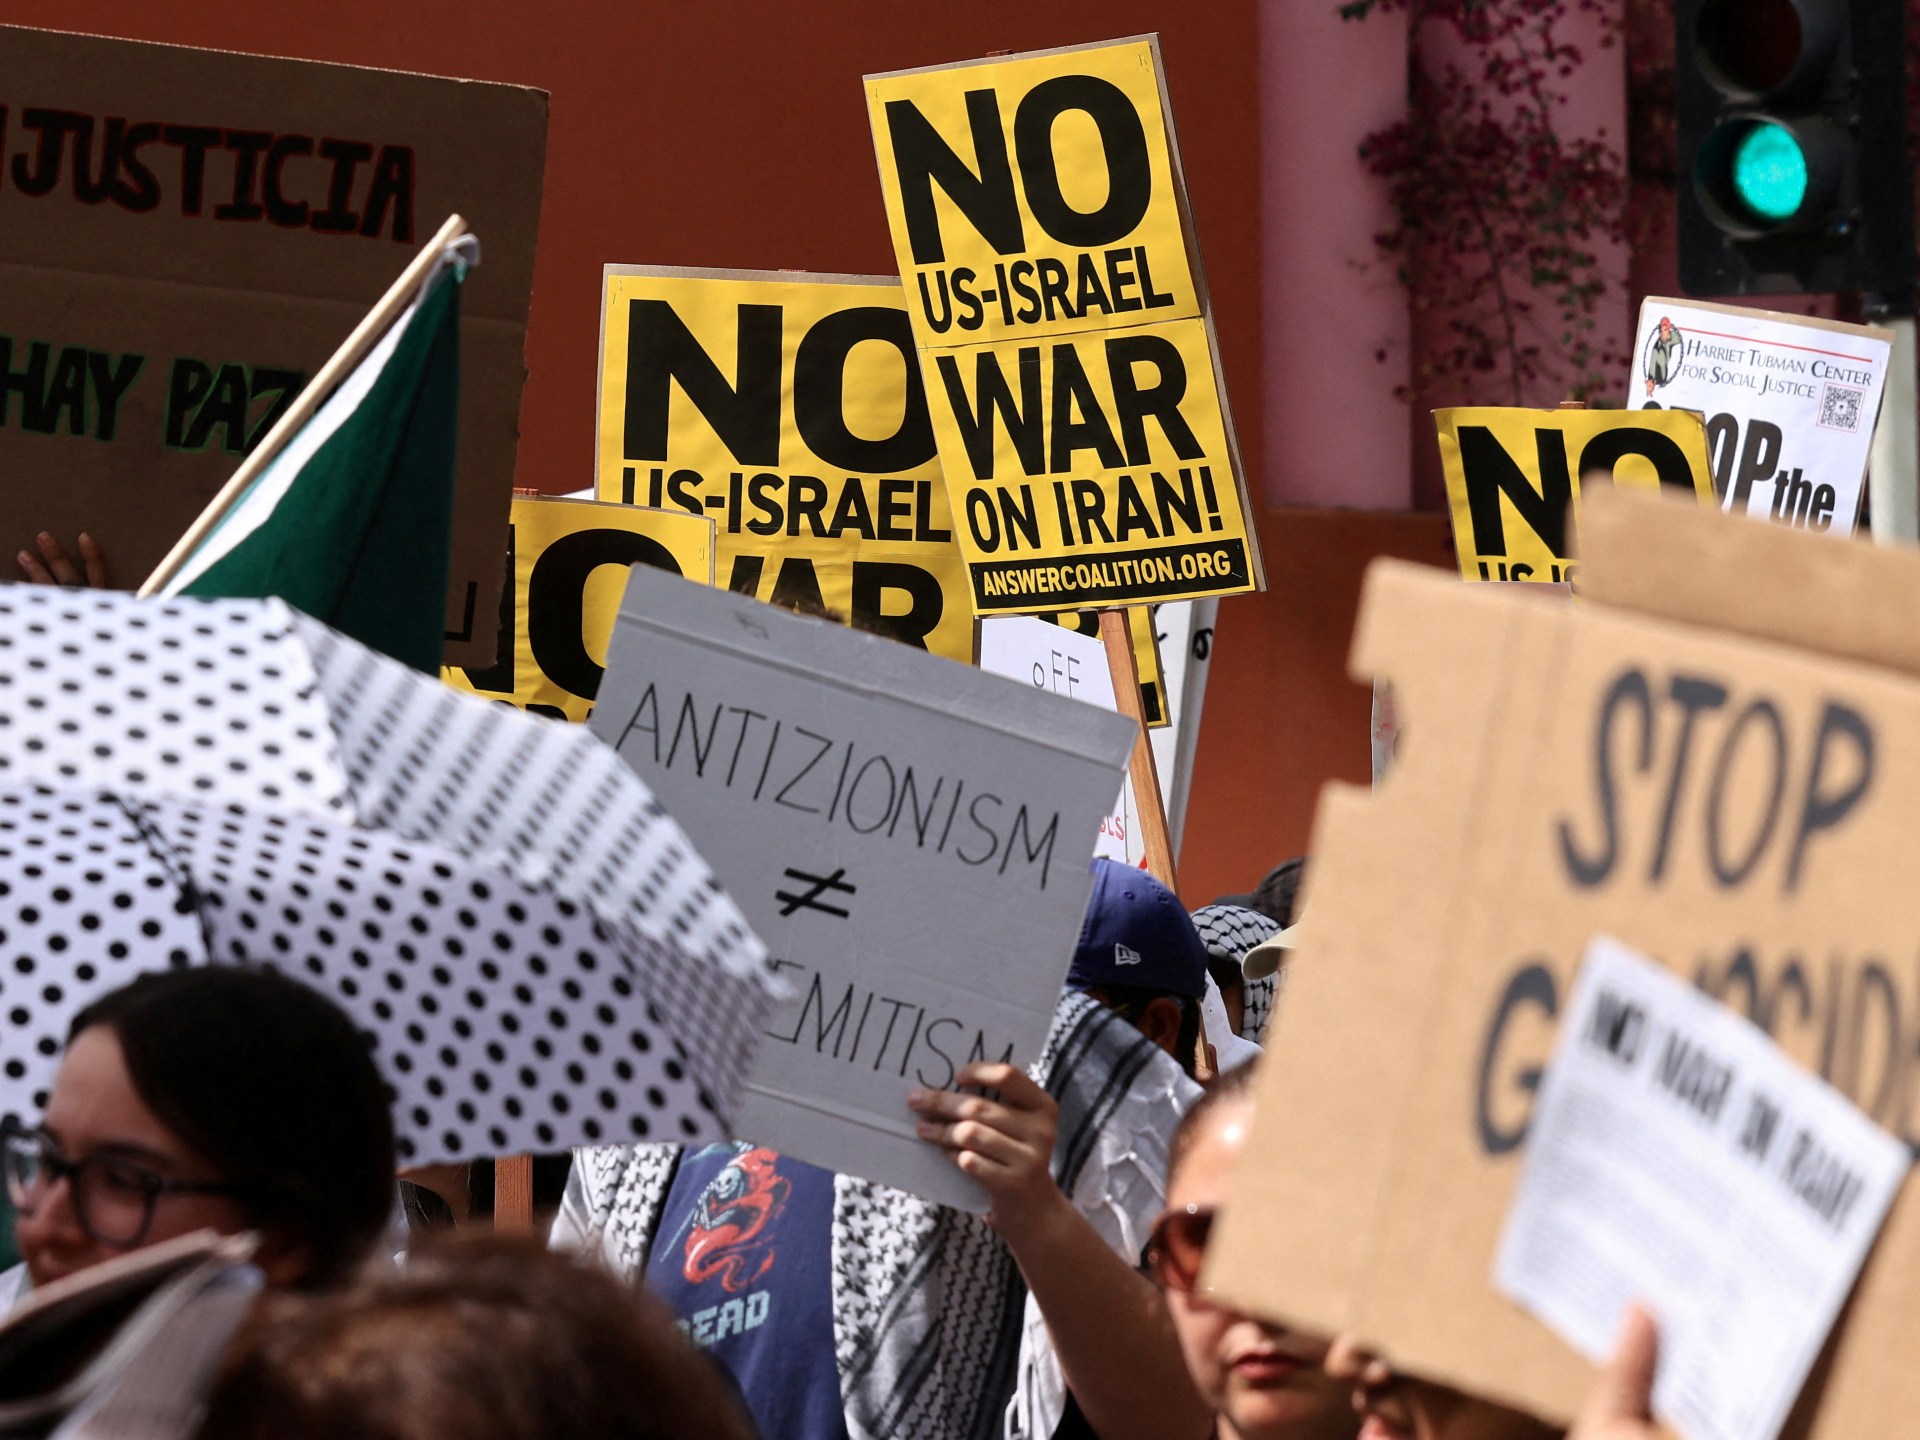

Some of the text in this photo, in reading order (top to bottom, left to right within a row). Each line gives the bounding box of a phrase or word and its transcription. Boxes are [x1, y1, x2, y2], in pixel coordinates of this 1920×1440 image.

[11, 107, 415, 244] JUSTICIA
[884, 75, 1152, 264] NO
[917, 246, 1175, 334] US-ISRAEL
[0, 334, 310, 458] HAY PAZ
[623, 299, 938, 473] NO
[937, 335, 1206, 480] WAR
[1687, 338, 1872, 387] HARRIET TUBMAN CENTER
[1709, 365, 1758, 390] SOCIAL
[1759, 375, 1818, 400] JUSTICE
[622, 467, 952, 543] US-ISRAEL
[965, 466, 1221, 553] ON IRAN!
[1642, 401, 1836, 533] OP the
[984, 550, 1231, 597] ANSWERCOALITION.ORG
[615, 683, 1059, 890] ANTIZIONISM
[1555, 667, 1877, 894] STOP
